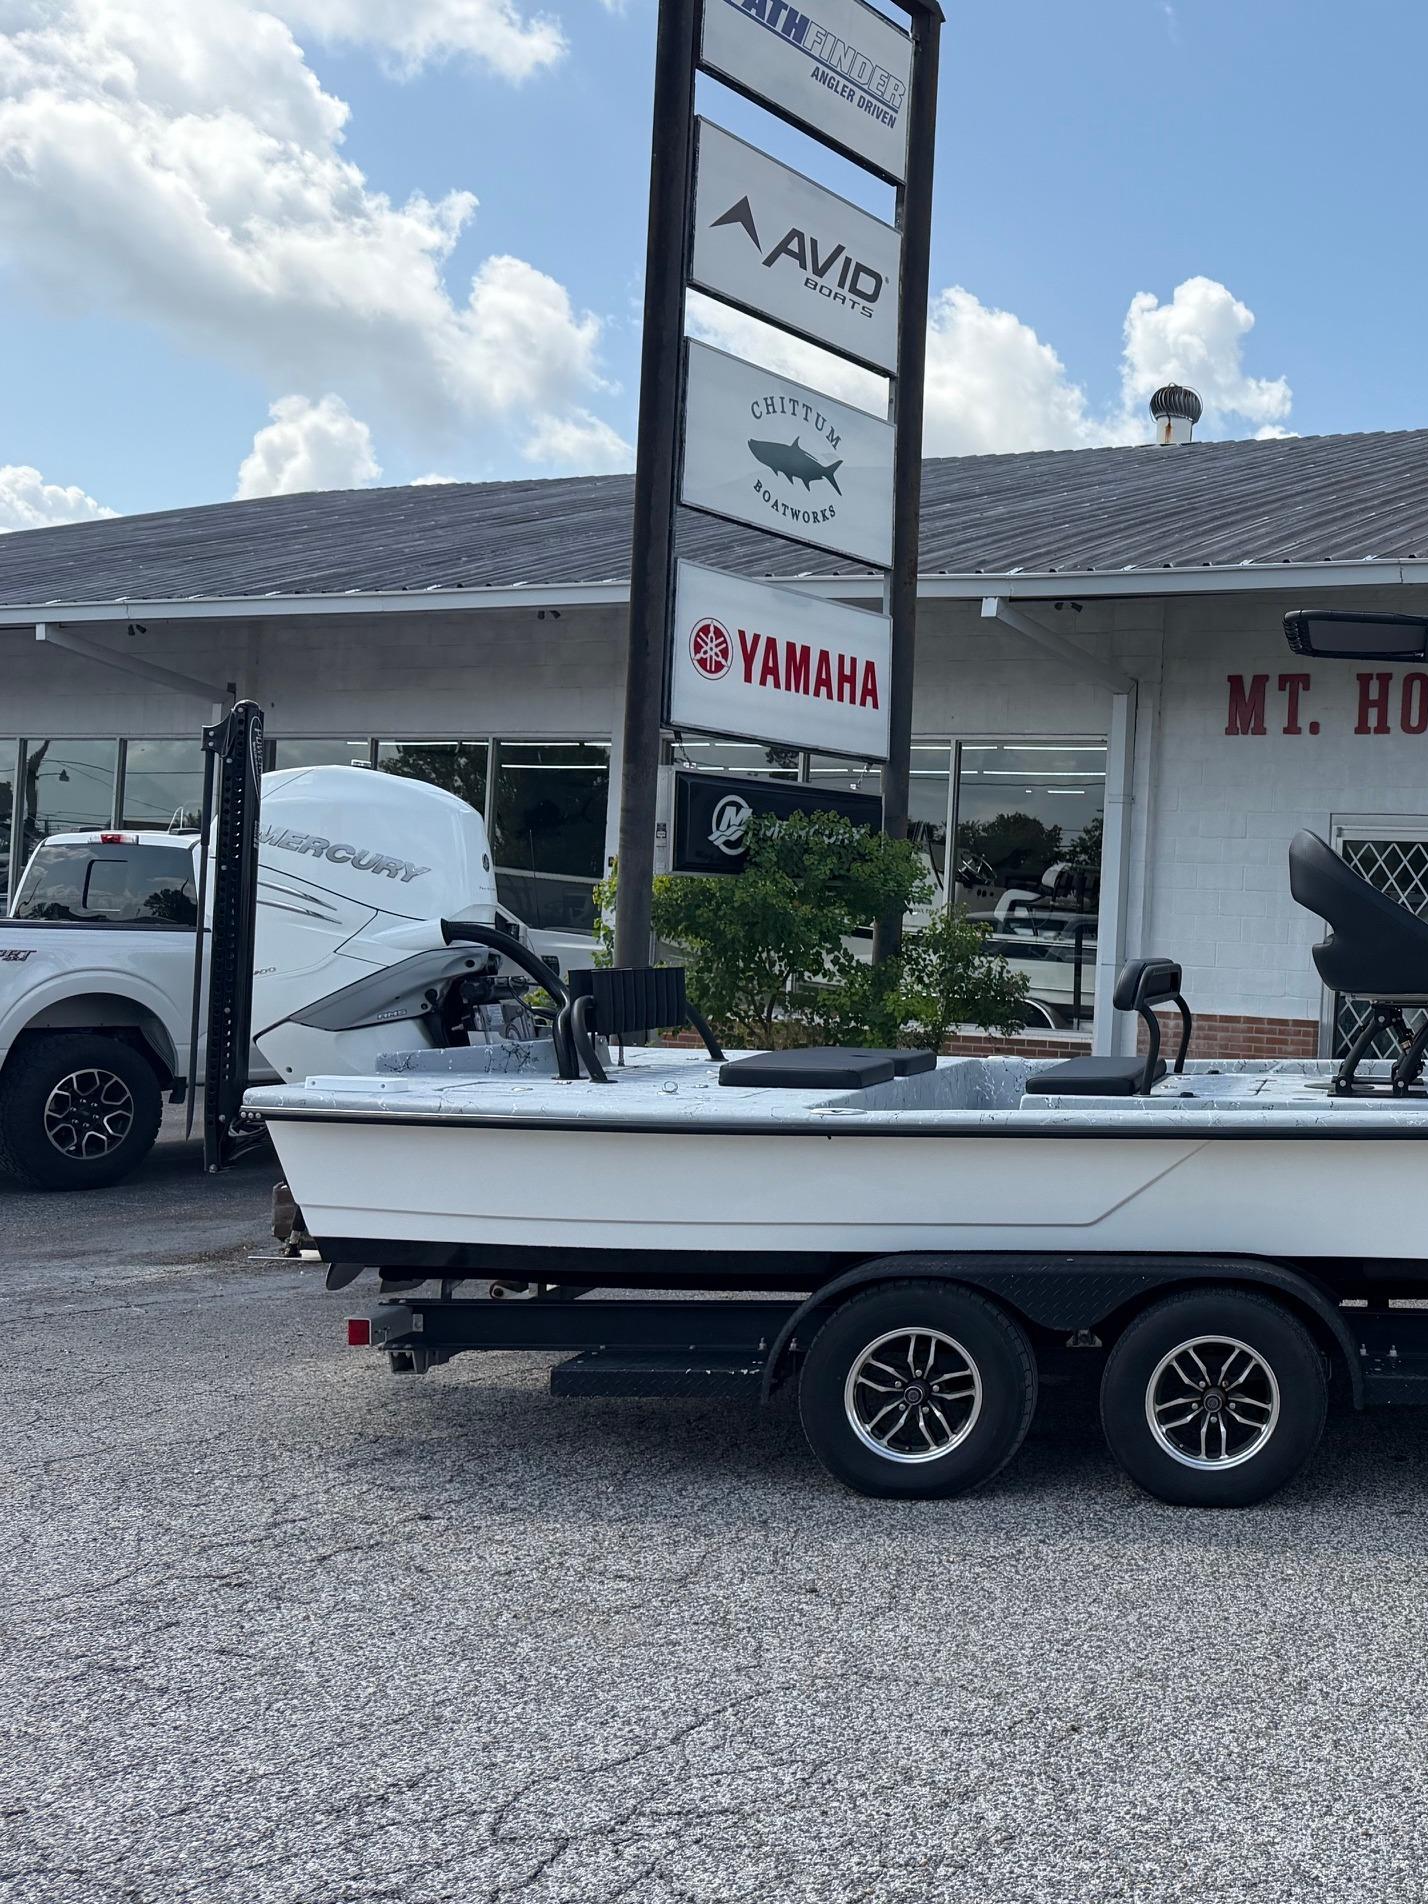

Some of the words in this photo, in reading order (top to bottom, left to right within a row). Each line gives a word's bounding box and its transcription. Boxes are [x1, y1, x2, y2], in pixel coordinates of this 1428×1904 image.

[725, 0, 907, 109] ATHFINDER
[810, 66, 856, 103] ANGLER
[856, 95, 897, 129] DRIVEN
[761, 227, 883, 304] AVID
[803, 277, 874, 319] BOATS
[750, 396, 842, 450] CHITTUM
[753, 479, 836, 523] BOATWORKS
[737, 629, 880, 710] YAMAHA
[1224, 673, 1321, 736] MT.
[259, 824, 432, 883] MERCURY
